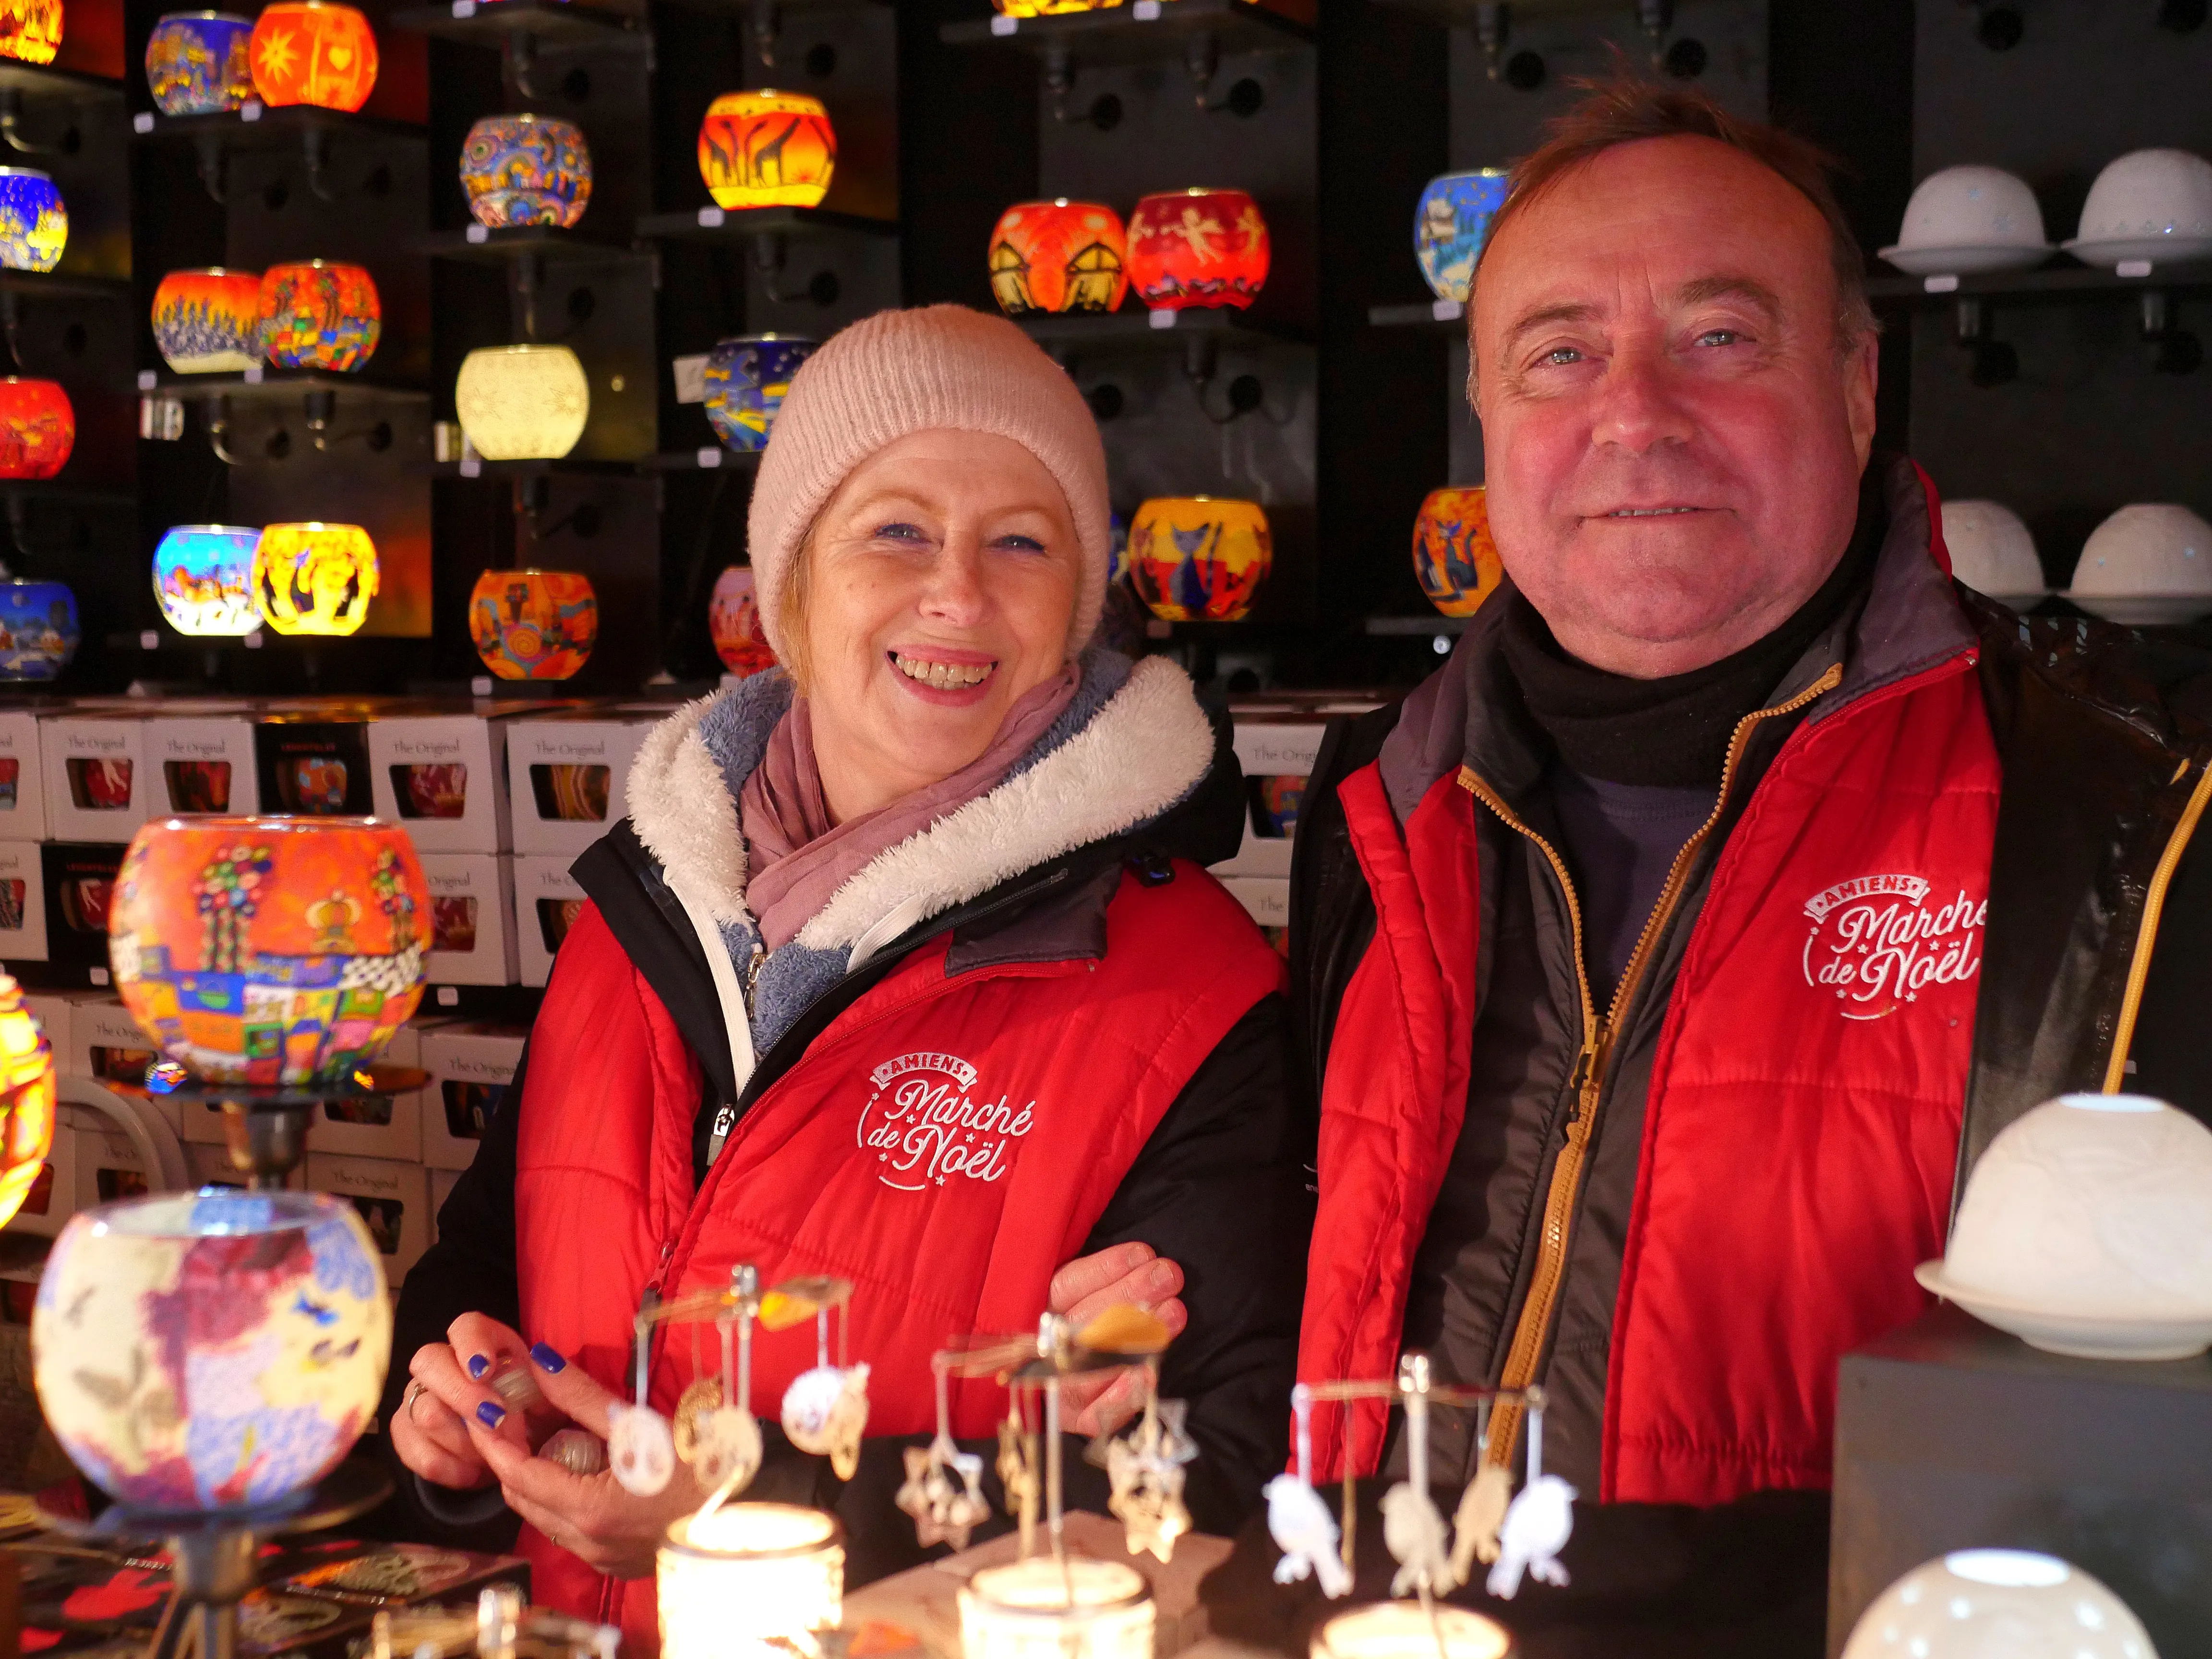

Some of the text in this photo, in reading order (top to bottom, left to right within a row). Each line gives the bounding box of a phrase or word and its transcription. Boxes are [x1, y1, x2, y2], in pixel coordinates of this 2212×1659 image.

[393, 736, 460, 758] The Original
[535, 740, 605, 760] The Original
[1253, 743, 1277, 761] The
[1824, 876, 1911, 907] AMIENS
[1258, 895, 1284, 912] The
[1818, 932, 1981, 1002] de Noël
[890, 1053, 964, 1076] AMIENS
[884, 1079, 1036, 1137] Marché
[867, 1121, 1007, 1182] de Noël
